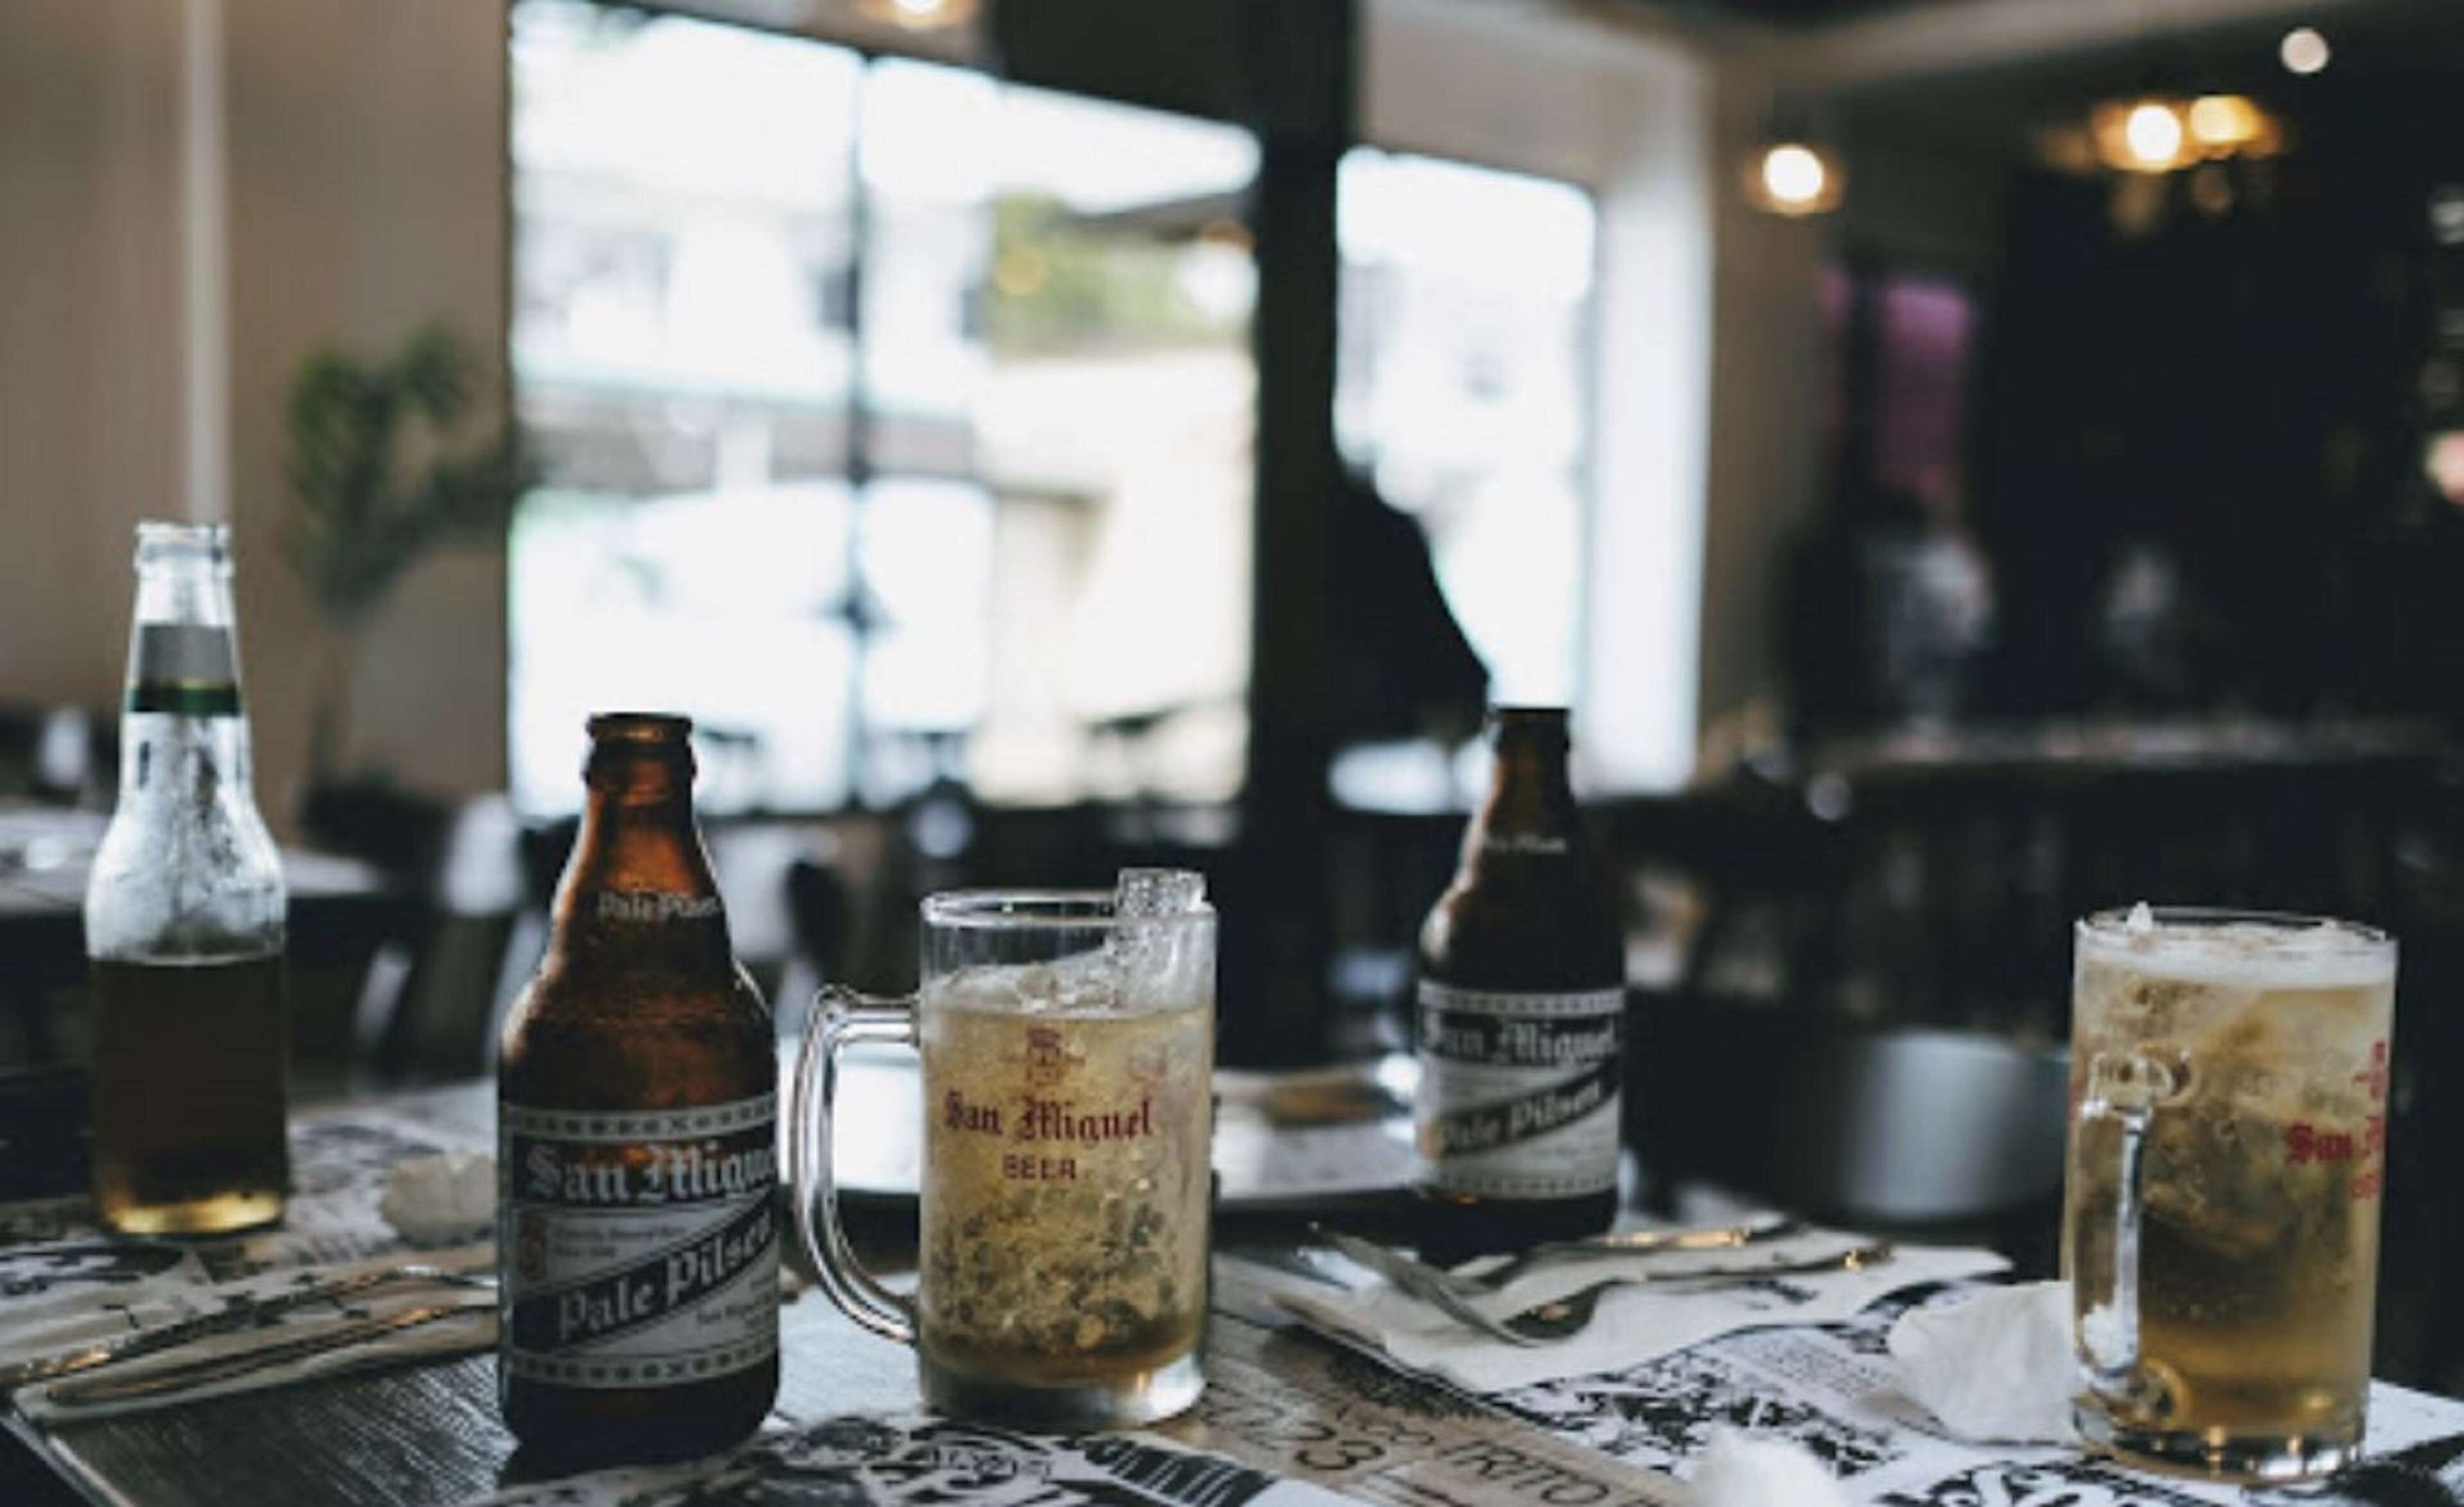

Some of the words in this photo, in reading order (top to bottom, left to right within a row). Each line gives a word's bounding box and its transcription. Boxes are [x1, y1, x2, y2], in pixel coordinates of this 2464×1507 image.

[944, 1089, 1003, 1135] San
[1013, 1093, 1153, 1150] Miguel
[524, 1142, 631, 1203] San
[1002, 1154, 1077, 1180] BEER
[558, 1276, 655, 1343] Pale
